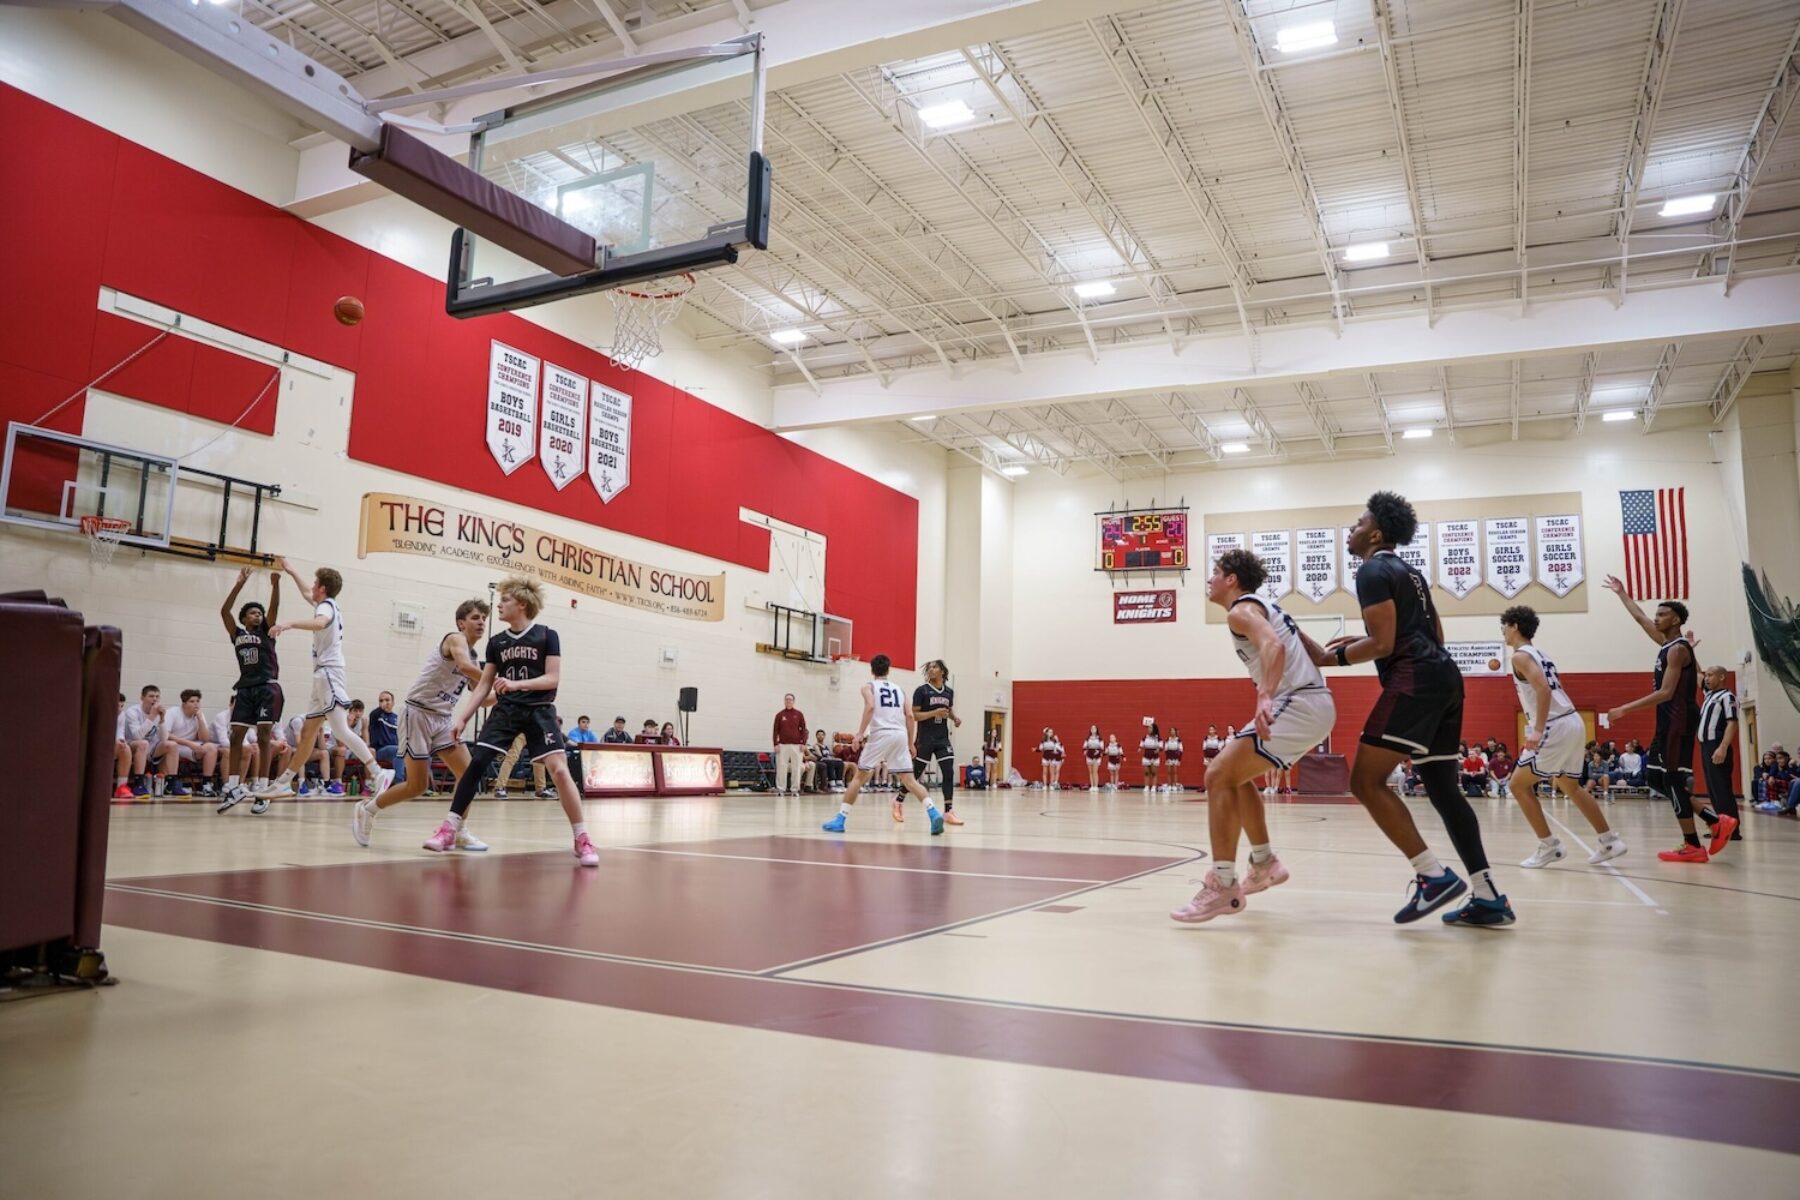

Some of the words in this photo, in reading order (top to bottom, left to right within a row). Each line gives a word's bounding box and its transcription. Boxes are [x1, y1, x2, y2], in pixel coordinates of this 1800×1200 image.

[497, 363, 532, 382] CONFERENCE
[498, 371, 530, 389] CHAMPIONS
[500, 391, 524, 410] BOYS
[549, 383, 581, 402] CONFERENCE
[550, 391, 579, 409] CHAMPIONS
[491, 402, 531, 423] BASKETBALL
[551, 410, 576, 428] GIRLS
[498, 418, 522, 437] 2019
[543, 420, 581, 440] BASKETBALL
[599, 427, 619, 444] BOYS
[549, 435, 573, 455] 2020
[591, 437, 625, 456] BASKETBALL
[597, 452, 617, 469] 2021
[380, 501, 445, 537] THE
[457, 514, 525, 558] KING'S
[536, 535, 642, 589] CHRISTIAN
[650, 570, 715, 603] SCHOOL
[1448, 548, 1469, 556] BOYS
[1495, 546, 1520, 554] GIRLS
[1543, 552, 1576, 561] SOCCER
[1546, 544, 1572, 552] GIRLS
[1443, 557, 1475, 565] SOCCER
[1492, 554, 1524, 563] SOCCER
[440, 546, 484, 562] ACADEMIC
[486, 555, 535, 574] EXCELLENCE
[538, 567, 557, 582] WITH
[559, 575, 585, 592] ABIDING
[1448, 567, 1471, 576] 2022
[1497, 565, 1520, 574] 2023
[1548, 563, 1573, 572] 2023
[1306, 573, 1328, 582] 2020
[1118, 594, 1158, 605] HOME
[1116, 608, 1172, 620] KNIGHTS
[500, 645, 538, 662] KNIGHTS
[880, 688, 900, 708] 21
